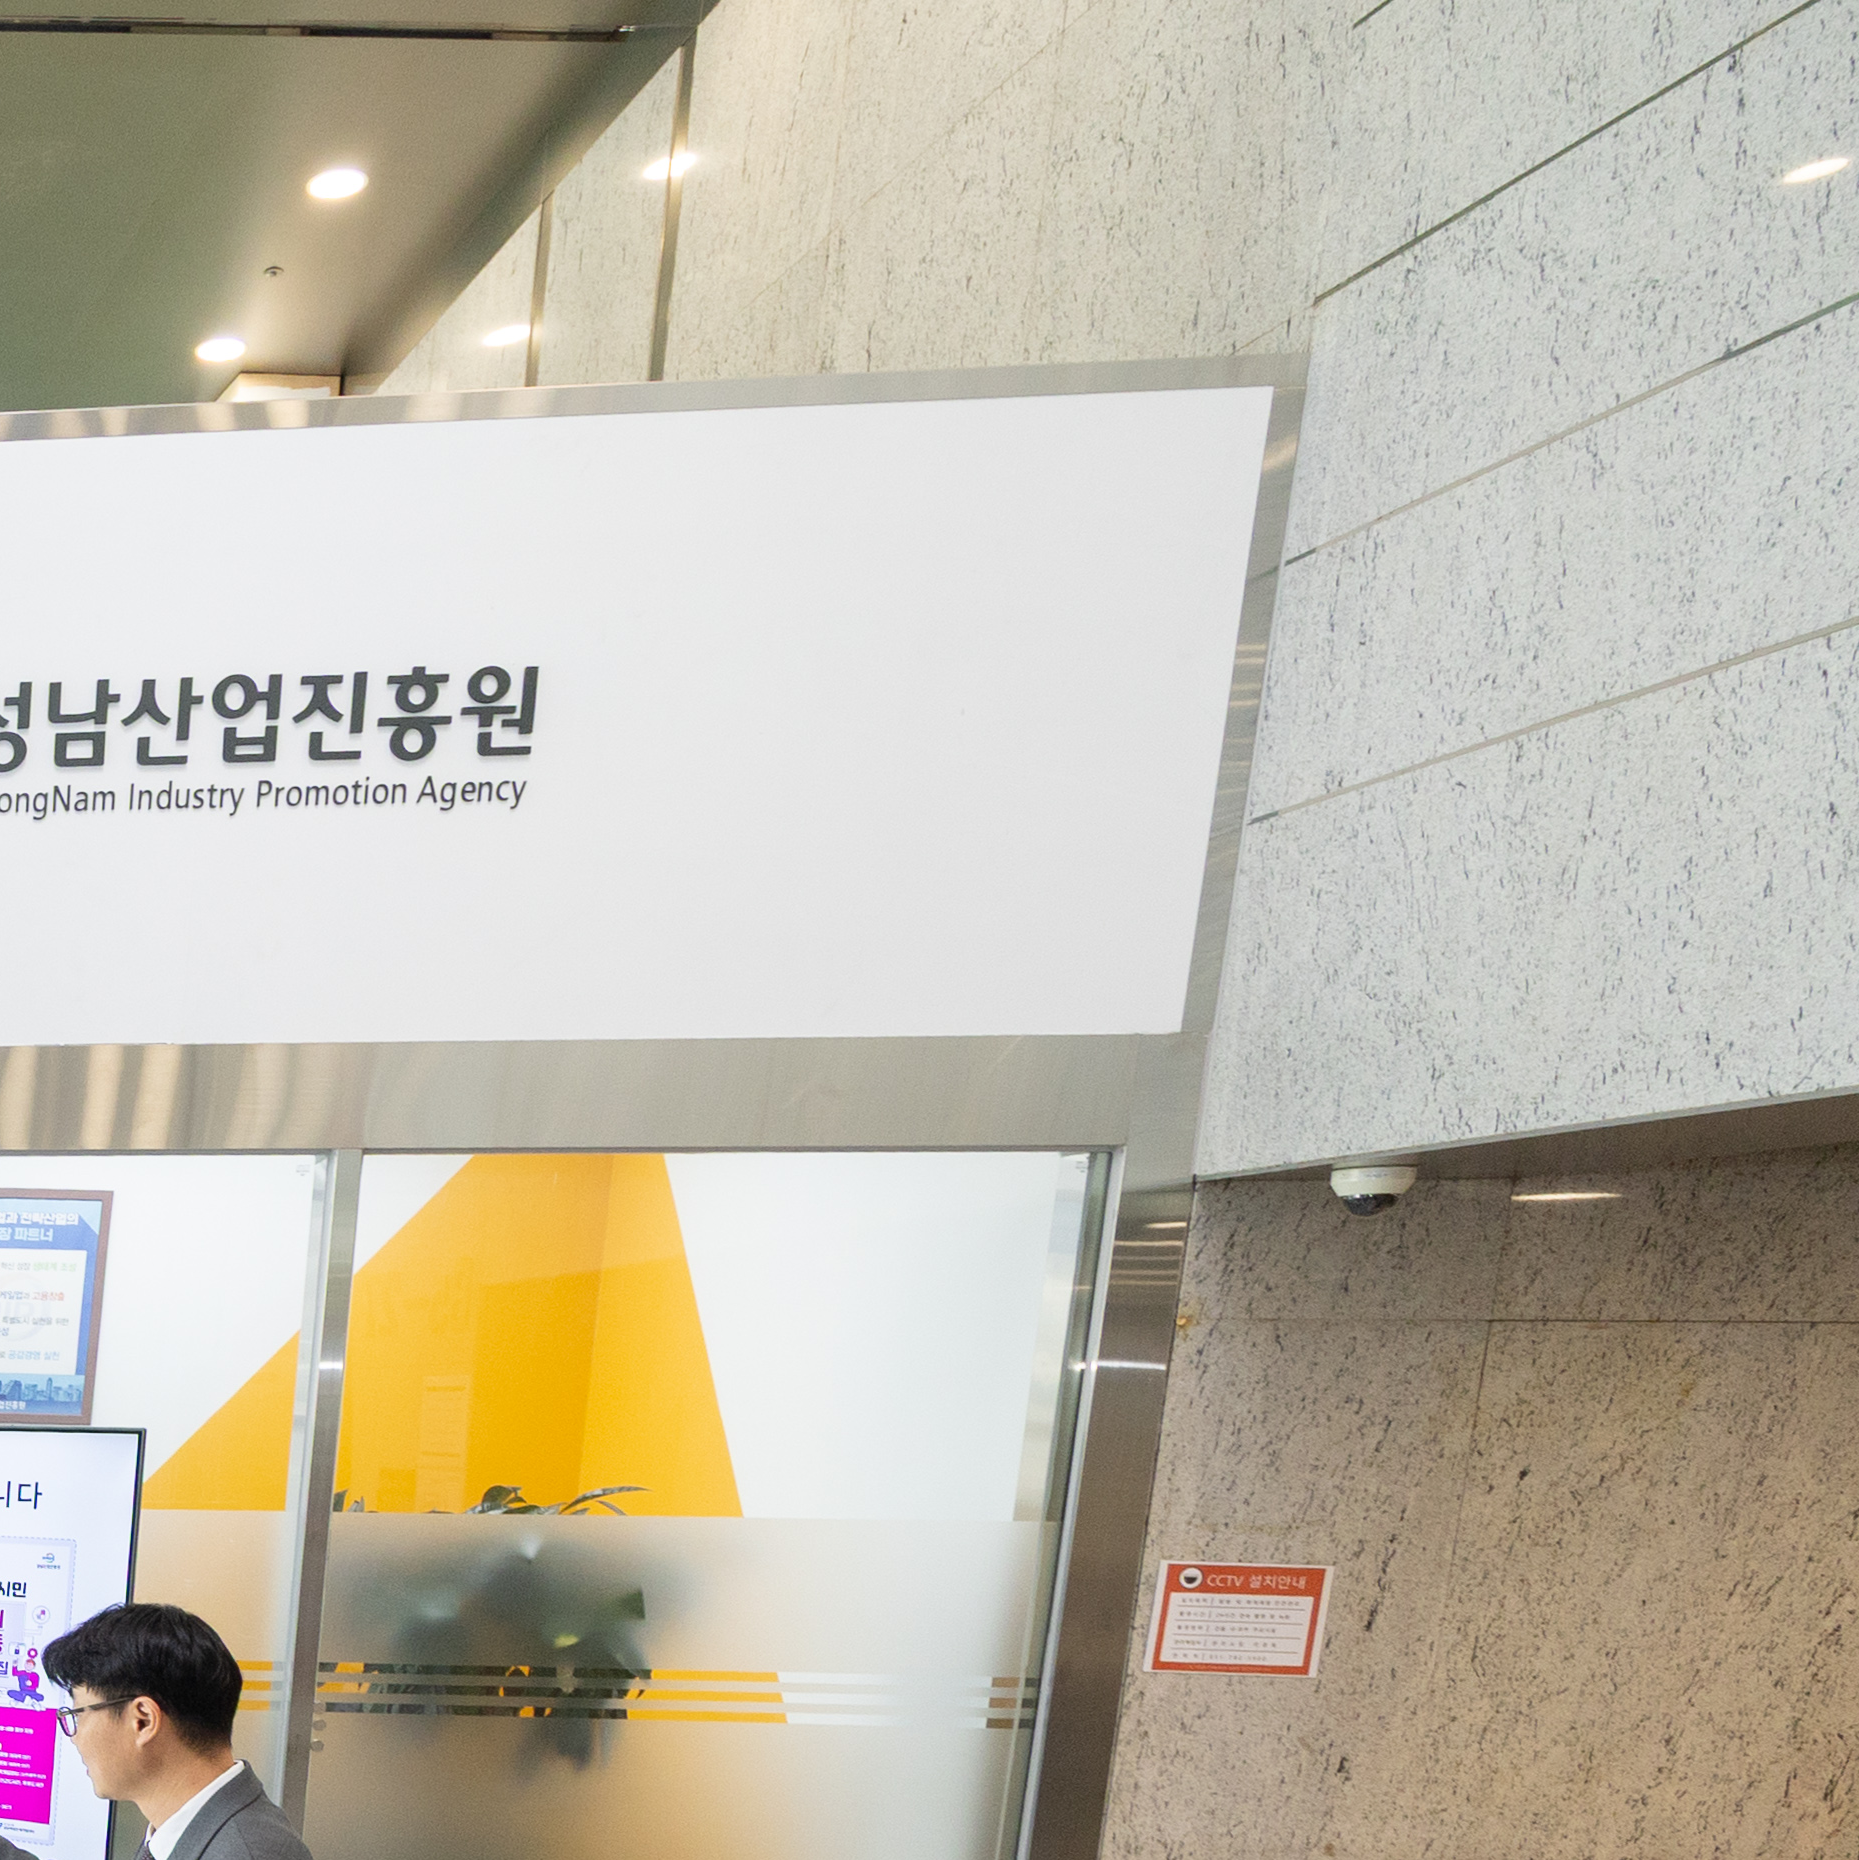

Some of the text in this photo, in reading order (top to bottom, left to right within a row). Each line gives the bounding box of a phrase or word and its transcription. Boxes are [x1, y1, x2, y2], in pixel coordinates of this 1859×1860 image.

[128, 780, 243, 816] Industry
[256, 775, 407, 808] Promotion
[416, 774, 526, 812] Agency
[15, 1228, 53, 1242] 파트너
[1207, 1574, 1307, 1590] CCTV 설치안내
